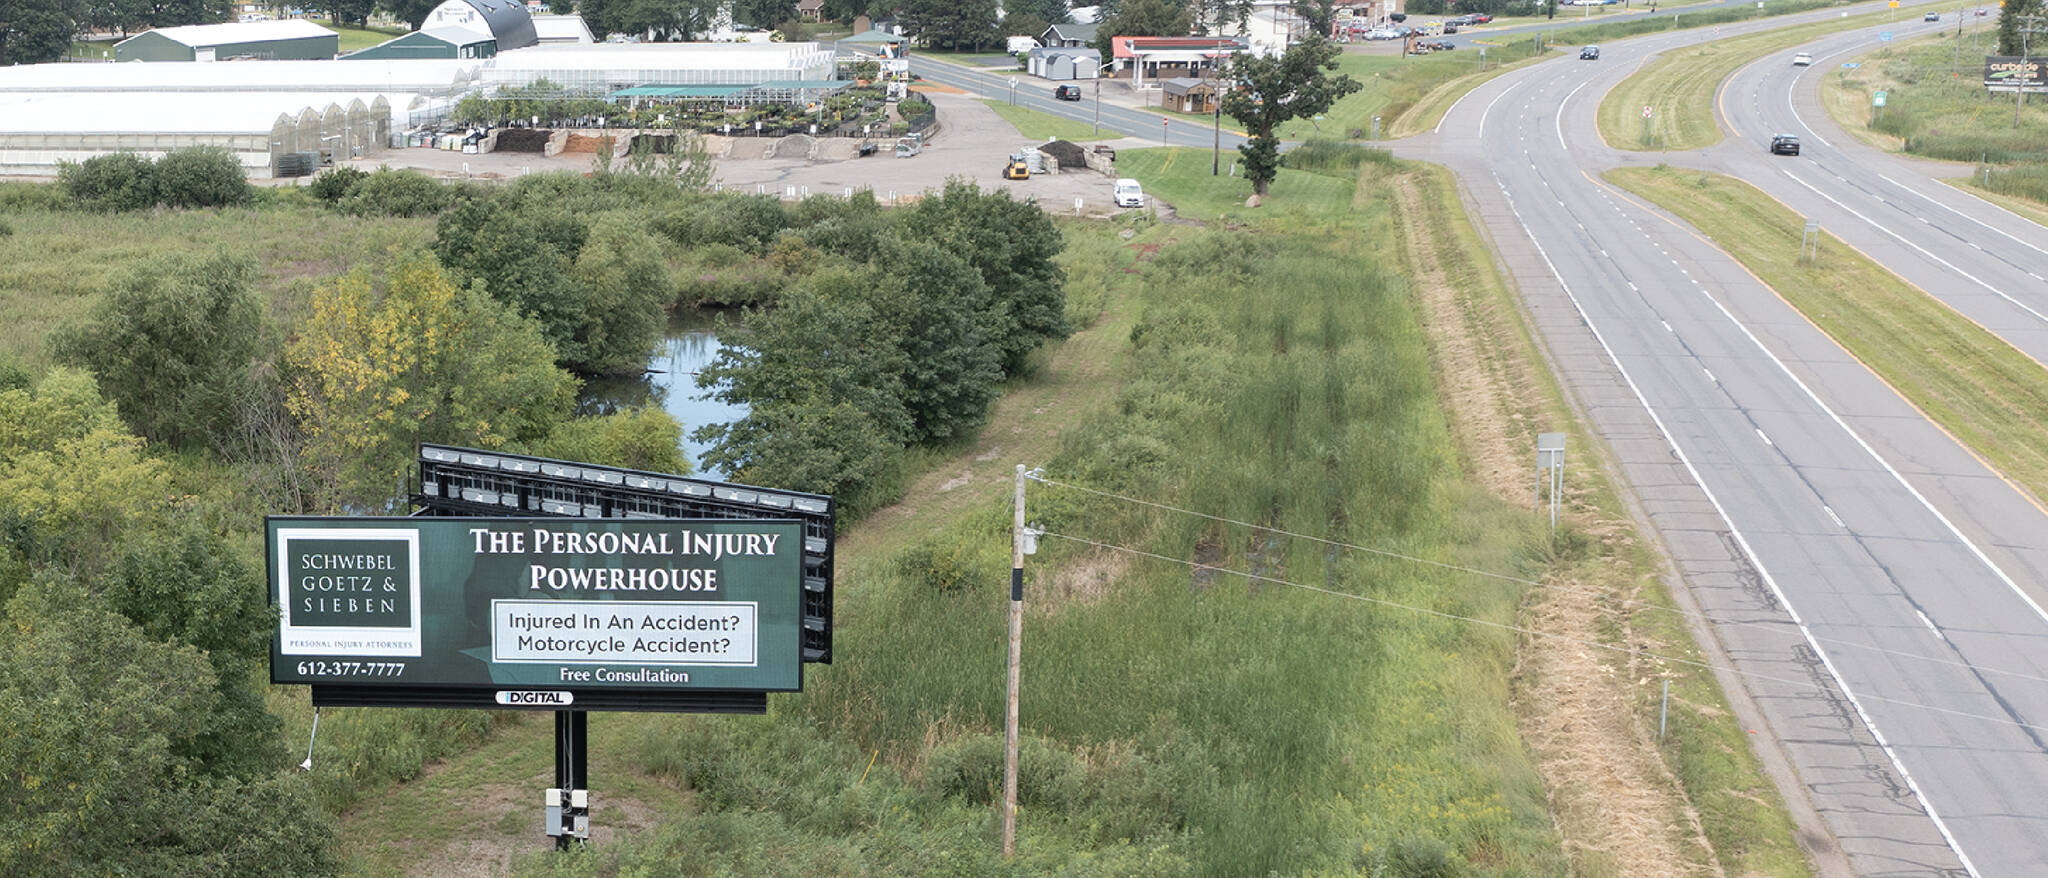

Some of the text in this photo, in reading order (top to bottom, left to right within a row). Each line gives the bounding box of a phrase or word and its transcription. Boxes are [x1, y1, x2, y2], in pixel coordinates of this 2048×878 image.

[470, 529, 780, 562] THE PERSONAL INJURY
[302, 554, 396, 570] SCHWEBEL
[302, 576, 397, 592] GOETZ &
[530, 565, 718, 591] POWERHOUSE
[304, 597, 395, 613] SIEBEN
[509, 613, 740, 631] Injured In An Accident?
[290, 640, 413, 649] PERSONAL INJURY ATTORNEYS
[518, 636, 731, 655] Motorcycle Accident?
[297, 661, 405, 677] 612-377-7777
[560, 667, 689, 683] Free Consultation
